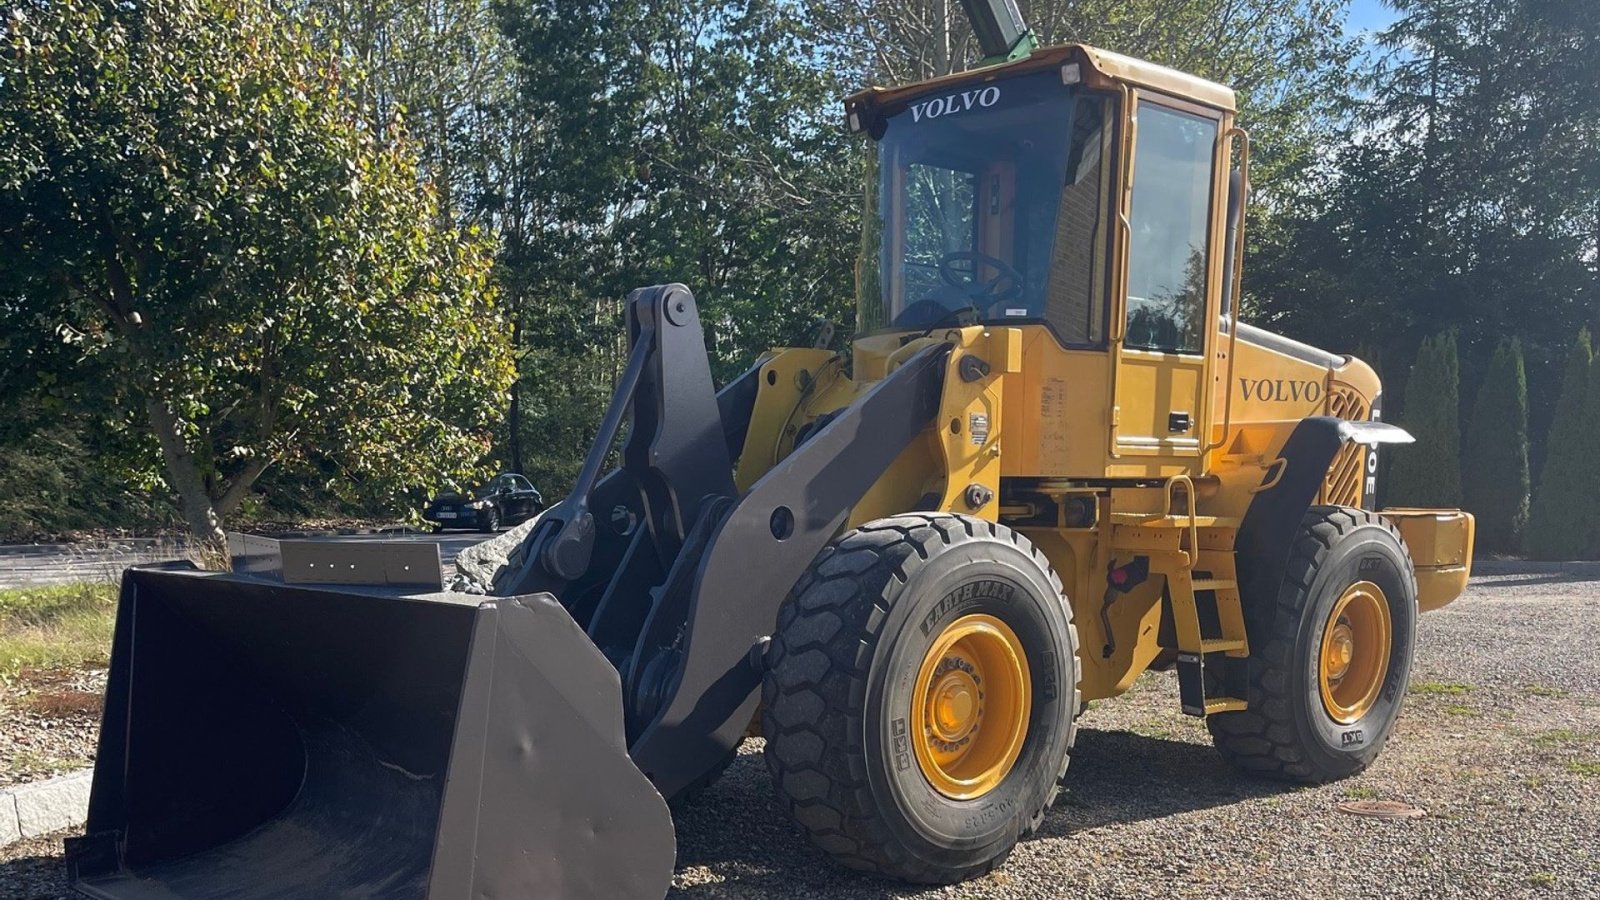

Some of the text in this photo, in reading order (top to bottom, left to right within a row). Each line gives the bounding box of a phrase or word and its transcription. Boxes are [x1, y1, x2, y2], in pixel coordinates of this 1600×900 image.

[910, 86, 1001, 123] VOLVO
[1239, 377, 1321, 402] VOLVO
[924, 581, 1012, 633] EARTH MAX
[892, 718, 910, 771] BKT
[1341, 730, 1363, 746] BKT
